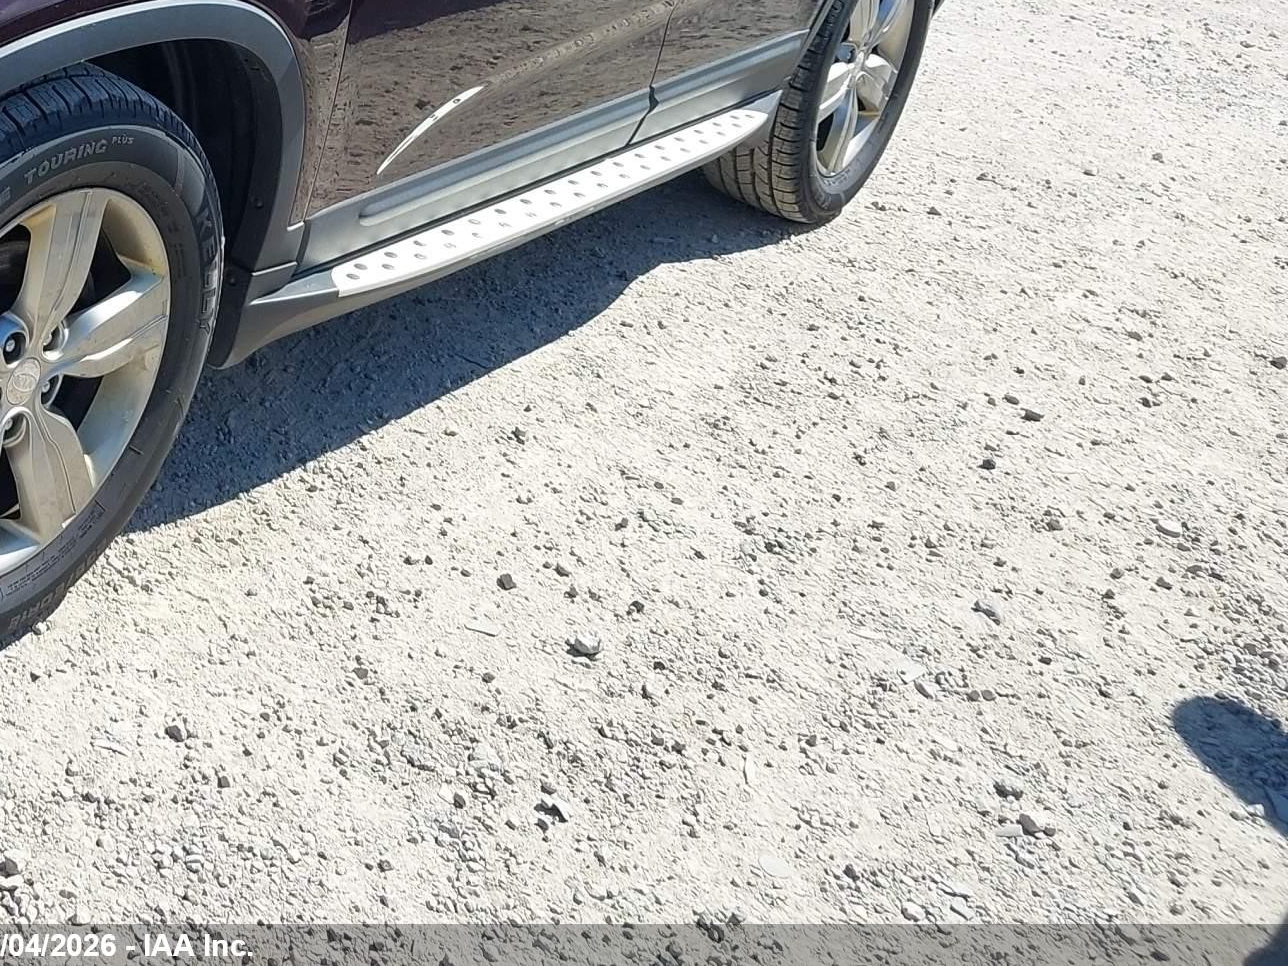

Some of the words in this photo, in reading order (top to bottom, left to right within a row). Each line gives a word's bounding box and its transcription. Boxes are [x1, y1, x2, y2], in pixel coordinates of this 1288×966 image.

[24, 139, 109, 185] TOURING
[112, 135, 134, 146] PLUS
[197, 208, 219, 335] KELLY
